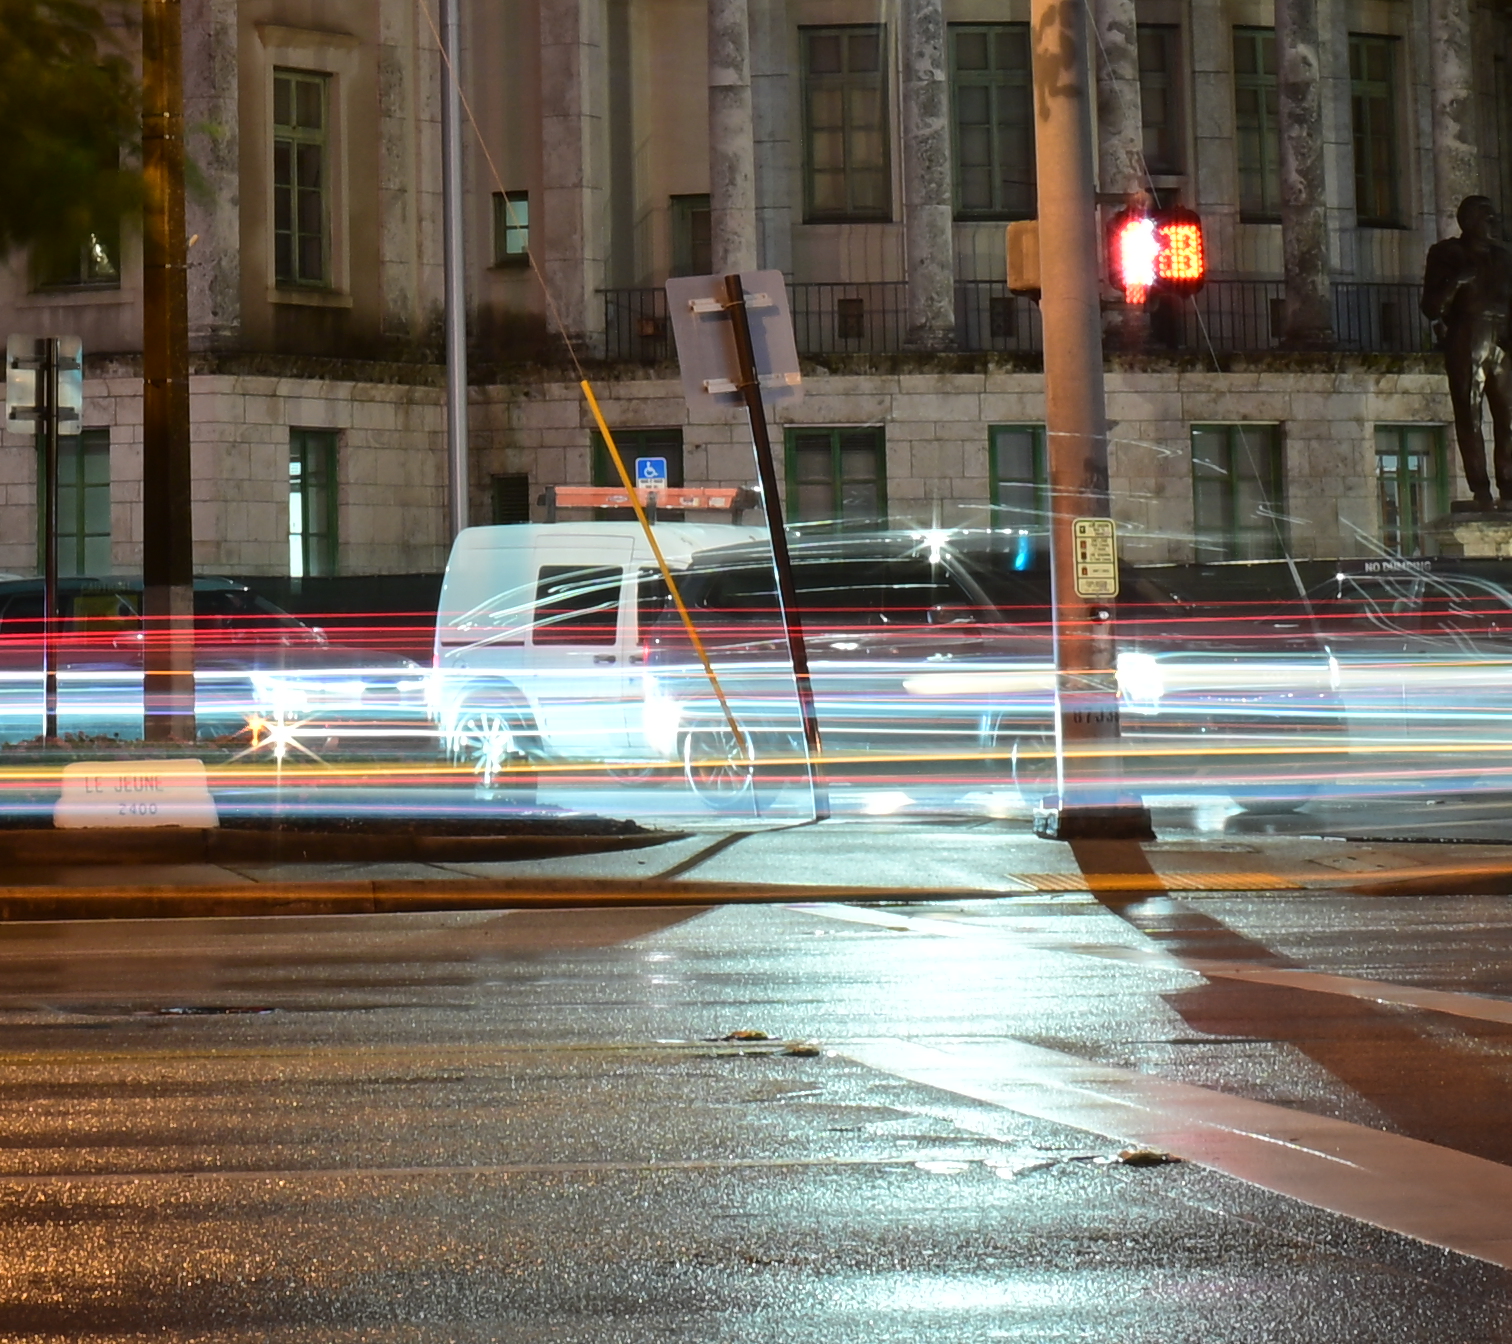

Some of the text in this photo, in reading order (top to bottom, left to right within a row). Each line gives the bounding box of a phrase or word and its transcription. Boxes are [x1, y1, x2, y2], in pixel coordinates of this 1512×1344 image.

[1364, 562, 1381, 573] NO
[85, 776, 164, 794] LE JEUNE
[119, 803, 158, 815] 2400
